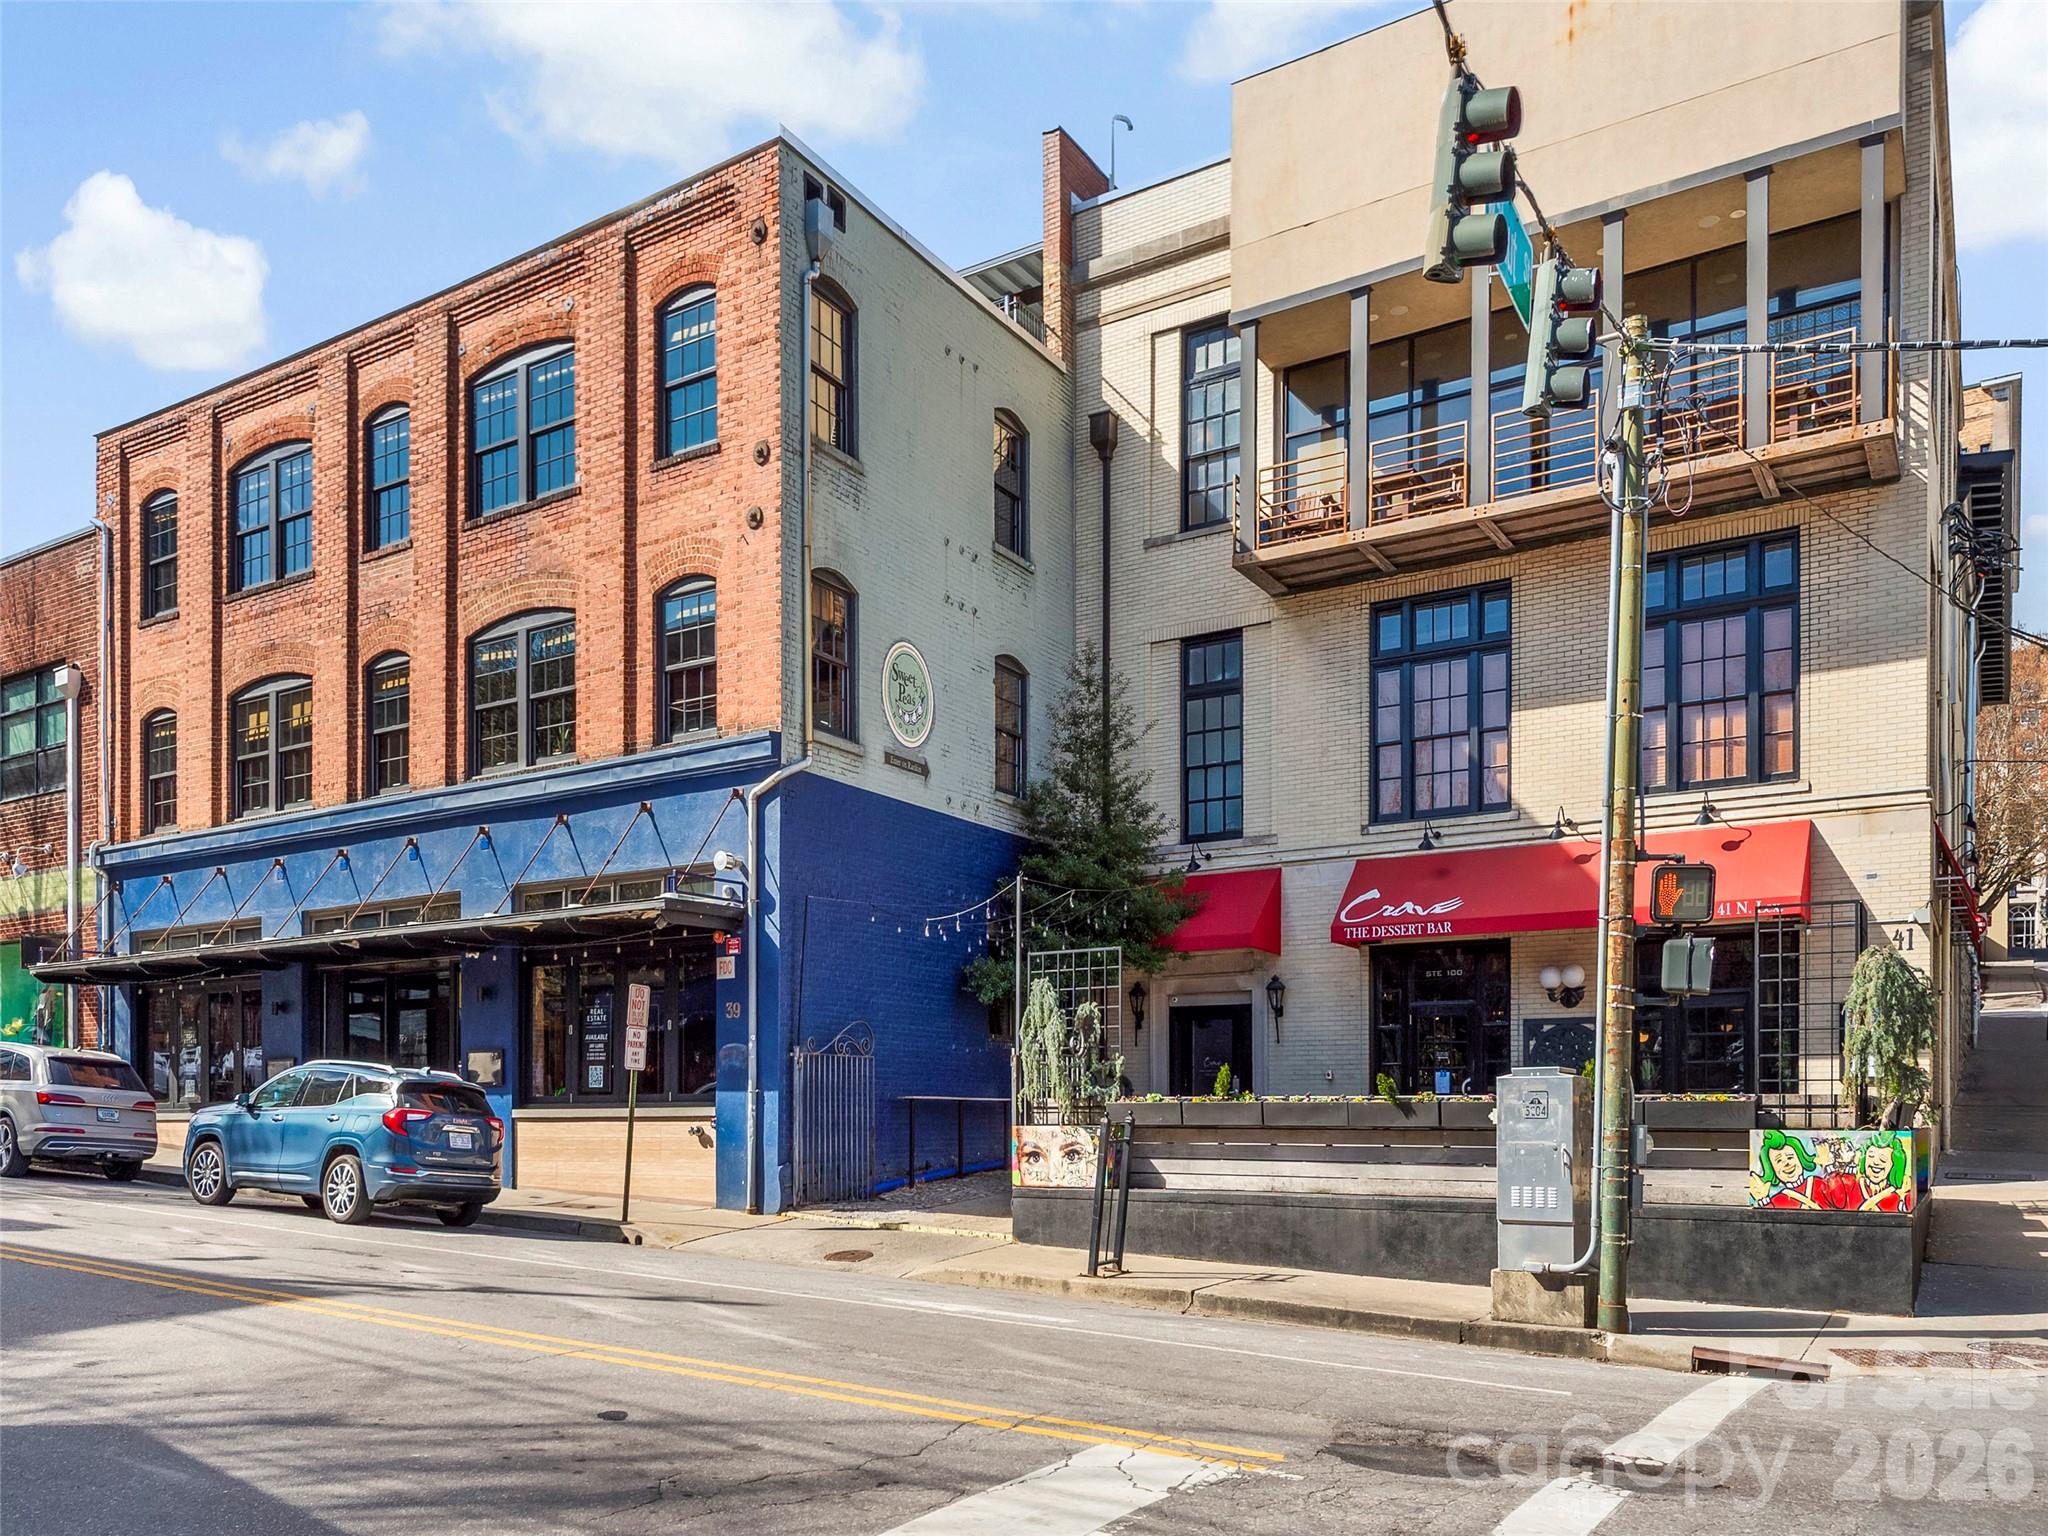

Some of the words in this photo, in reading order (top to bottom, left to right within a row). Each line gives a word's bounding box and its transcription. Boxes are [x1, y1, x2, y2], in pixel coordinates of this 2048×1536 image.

[892, 662, 917, 688] Sweet
[898, 682, 916, 706] Peas
[1340, 888, 1465, 923] Crave
[1717, 902, 1731, 916] 41
[1736, 901, 1752, 914] N.
[1344, 926, 1370, 939] THE
[1372, 923, 1425, 938] DESSERT
[1427, 921, 1453, 934] BAR
[1893, 928, 1914, 951] 41
[720, 960, 733, 975] FDC
[635, 987, 645, 999] DO
[631, 999, 646, 1010] NOT
[726, 1002, 741, 1018] 39
[632, 1031, 641, 1040] NO
[627, 1040, 645, 1049] PARKING
